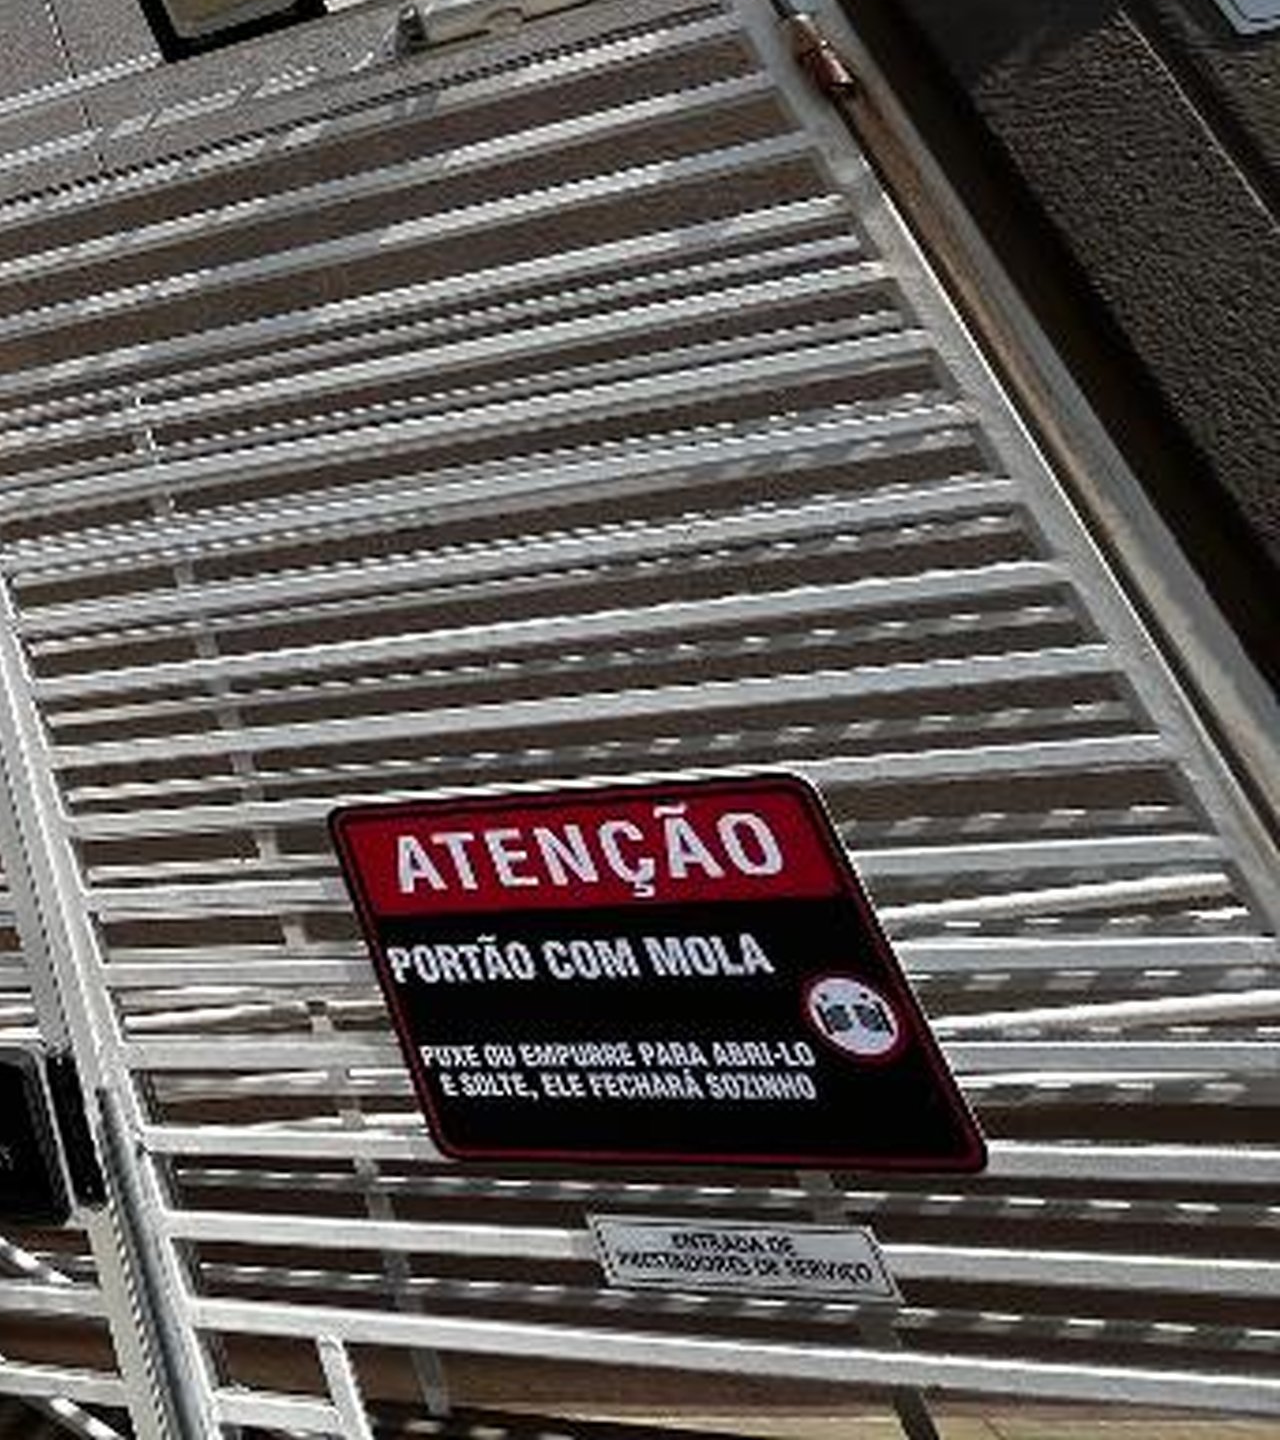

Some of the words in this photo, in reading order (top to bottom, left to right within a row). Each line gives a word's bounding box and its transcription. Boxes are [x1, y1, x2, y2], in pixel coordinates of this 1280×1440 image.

[397, 803, 783, 898] ATENÇÃO
[386, 934, 536, 984] PORTÃO
[541, 937, 640, 981] COM
[643, 933, 775, 977] MOLA
[419, 1044, 479, 1068] PUXE
[484, 1044, 516, 1067] OU
[518, 1042, 636, 1067] EMPURRE
[639, 1041, 709, 1067] PARA
[711, 1040, 817, 1068] ABRI-LO
[440, 1073, 459, 1097] E
[460, 1071, 540, 1101] SOLTE,
[542, 1072, 590, 1098] ELE
[588, 1068, 705, 1099] FECHARÁ
[706, 1071, 818, 1101] SOZINHO
